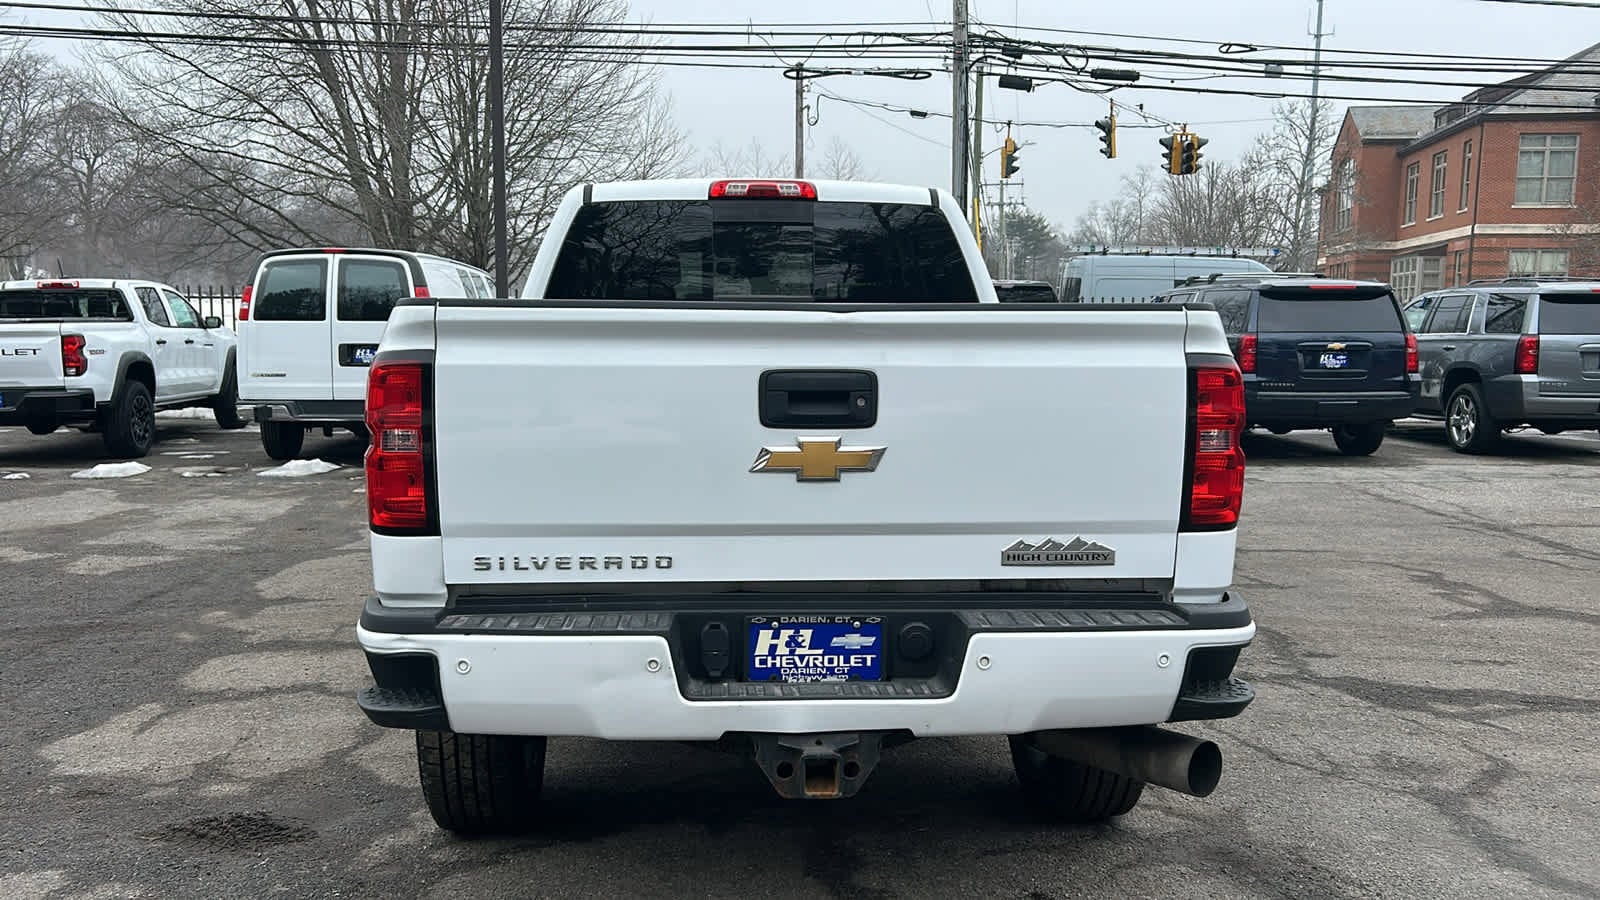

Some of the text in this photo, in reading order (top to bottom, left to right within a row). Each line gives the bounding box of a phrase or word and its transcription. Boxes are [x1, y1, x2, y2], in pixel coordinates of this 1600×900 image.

[473, 555, 673, 571] SILVERADO
[1006, 553, 1110, 562] HIGH COUNTRY
[834, 616, 854, 624] CT.
[754, 629, 824, 655] H&L
[755, 655, 877, 668] CHEVROLET
